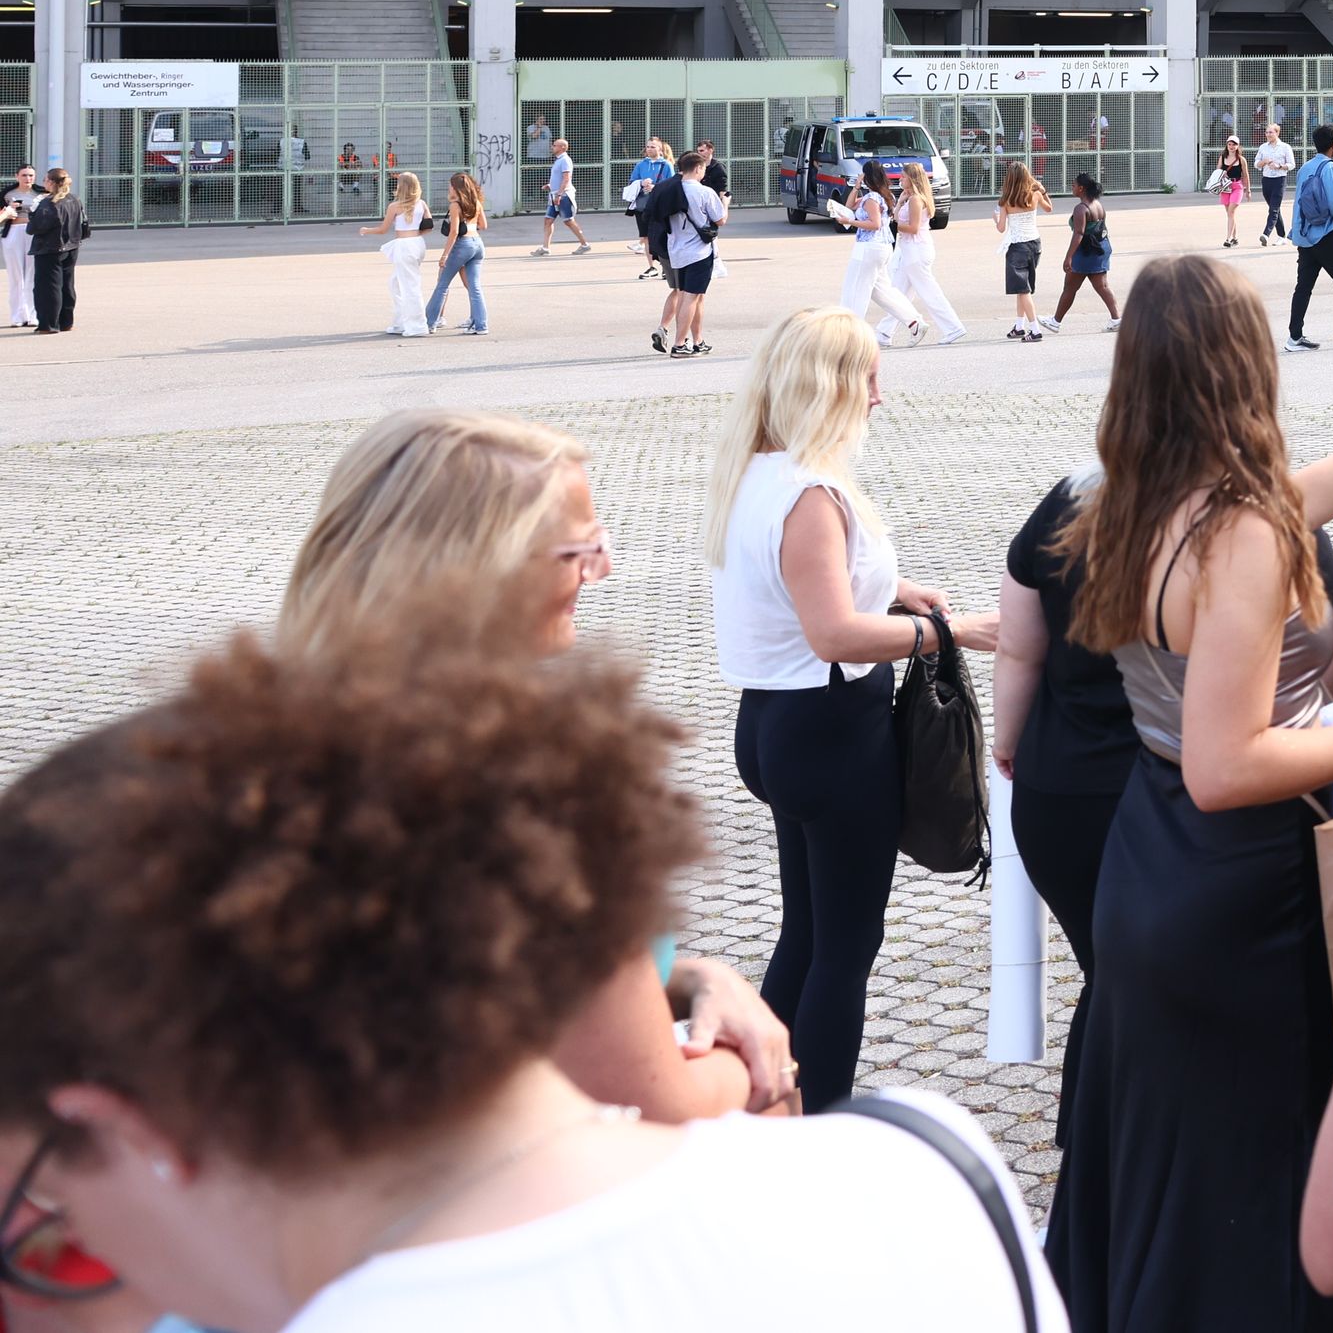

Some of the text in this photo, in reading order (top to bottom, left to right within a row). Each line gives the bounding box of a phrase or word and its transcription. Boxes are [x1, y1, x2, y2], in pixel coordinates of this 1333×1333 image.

[939, 61, 957, 70] den
[960, 60, 999, 70] Sektoren
[1061, 60, 1129, 70] zu den Sektoren
[90, 72, 184, 82] Gewichtheber-, Ringer
[926, 73, 937, 91] C
[958, 73, 969, 90] D
[990, 72, 999, 90] E
[1062, 72, 1071, 89] B
[1091, 72, 1101, 88] A
[1121, 71, 1129, 88] F
[102, 81, 194, 90] und Wasserspringer-
[130, 89, 168, 97] Zentrum
